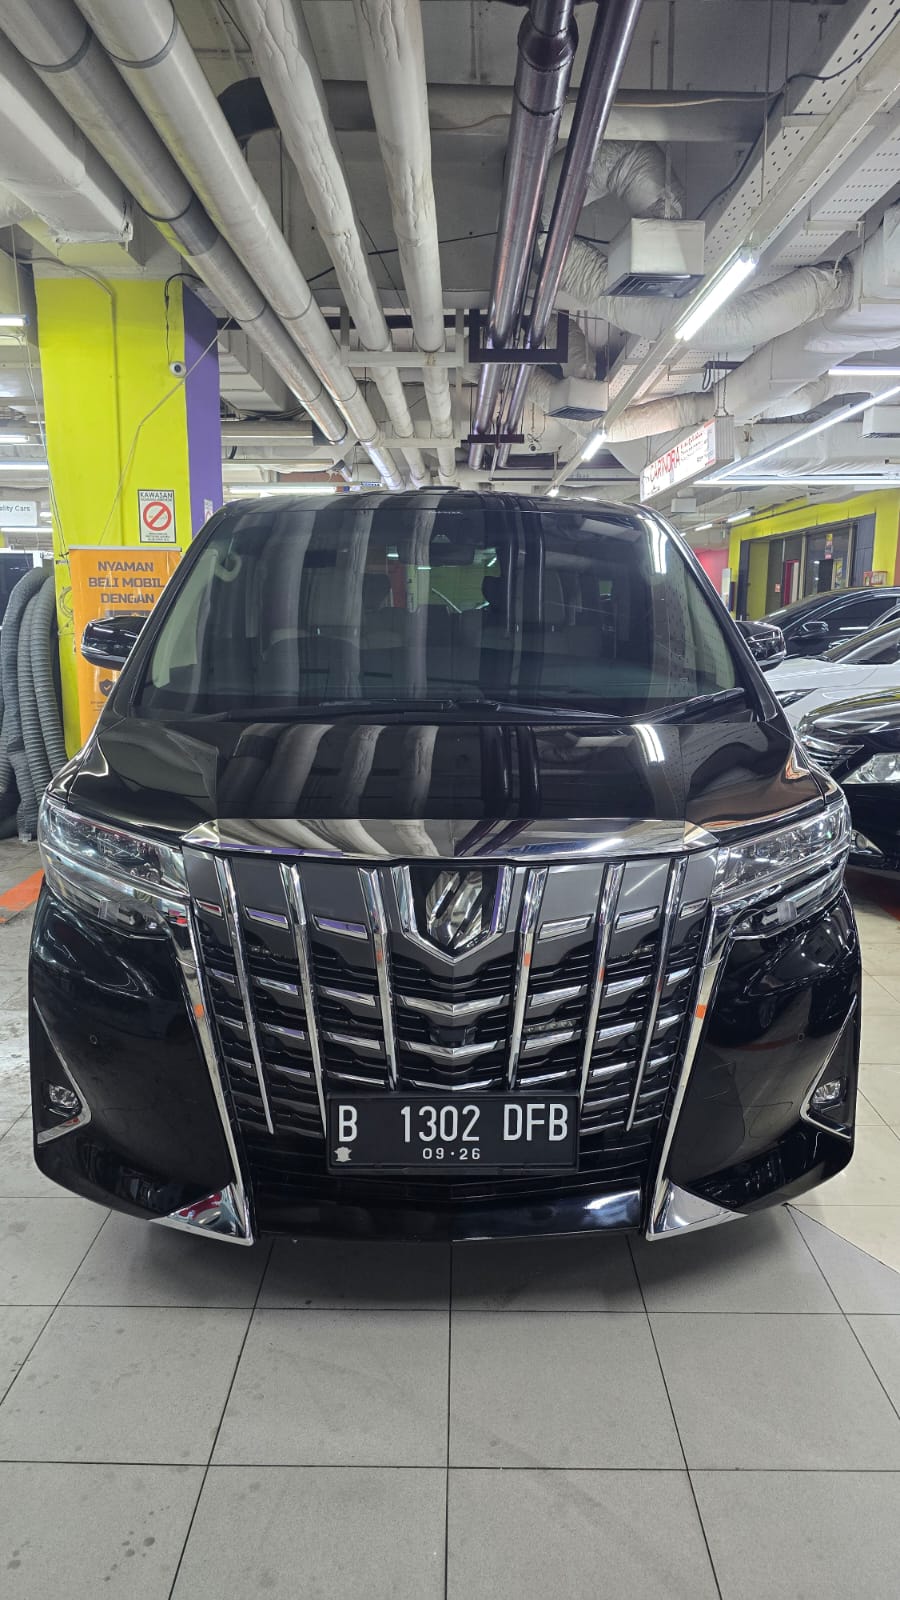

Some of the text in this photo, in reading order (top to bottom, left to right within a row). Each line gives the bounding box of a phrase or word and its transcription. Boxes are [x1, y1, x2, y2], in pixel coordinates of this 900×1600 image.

[97, 560, 154, 572] NYAMAN
[88, 577, 165, 588] BELI MOBIL
[100, 593, 154, 604] DENGAN
[338, 1103, 569, 1143] B 1302 DFB
